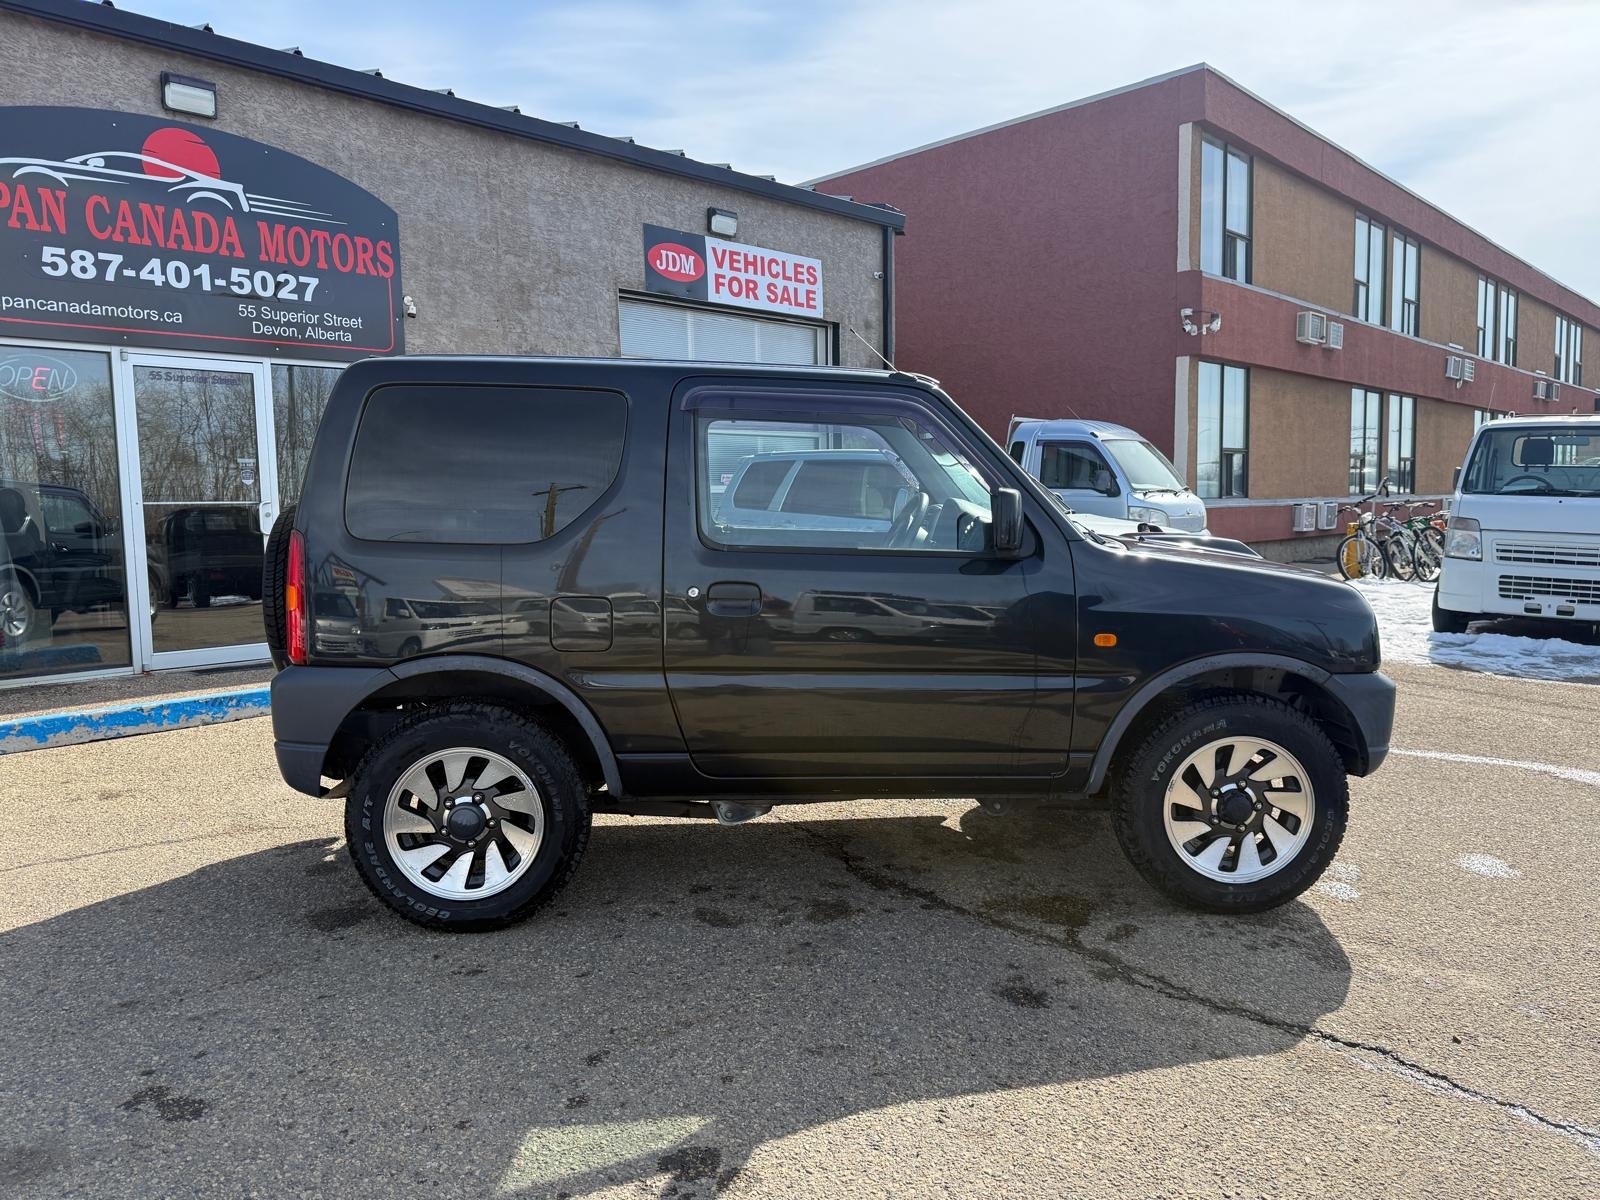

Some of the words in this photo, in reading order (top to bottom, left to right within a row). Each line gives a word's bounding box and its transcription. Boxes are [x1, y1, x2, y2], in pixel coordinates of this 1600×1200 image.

[85, 195, 245, 258] CANADA
[256, 221, 394, 279] MOTORS
[41, 246, 319, 302] 587-401-5027
[656, 249, 696, 276] JDM
[711, 246, 817, 286] VEHICLES
[714, 273, 759, 301] FOR
[766, 282, 817, 310] SALE
[238, 304, 256, 318] 55
[261, 306, 319, 325] Superior
[323, 312, 363, 329] Street
[252, 321, 302, 340] Devon,
[305, 326, 352, 342] Alberta
[0, 365, 69, 390] OPEN
[149, 370, 162, 381] 55
